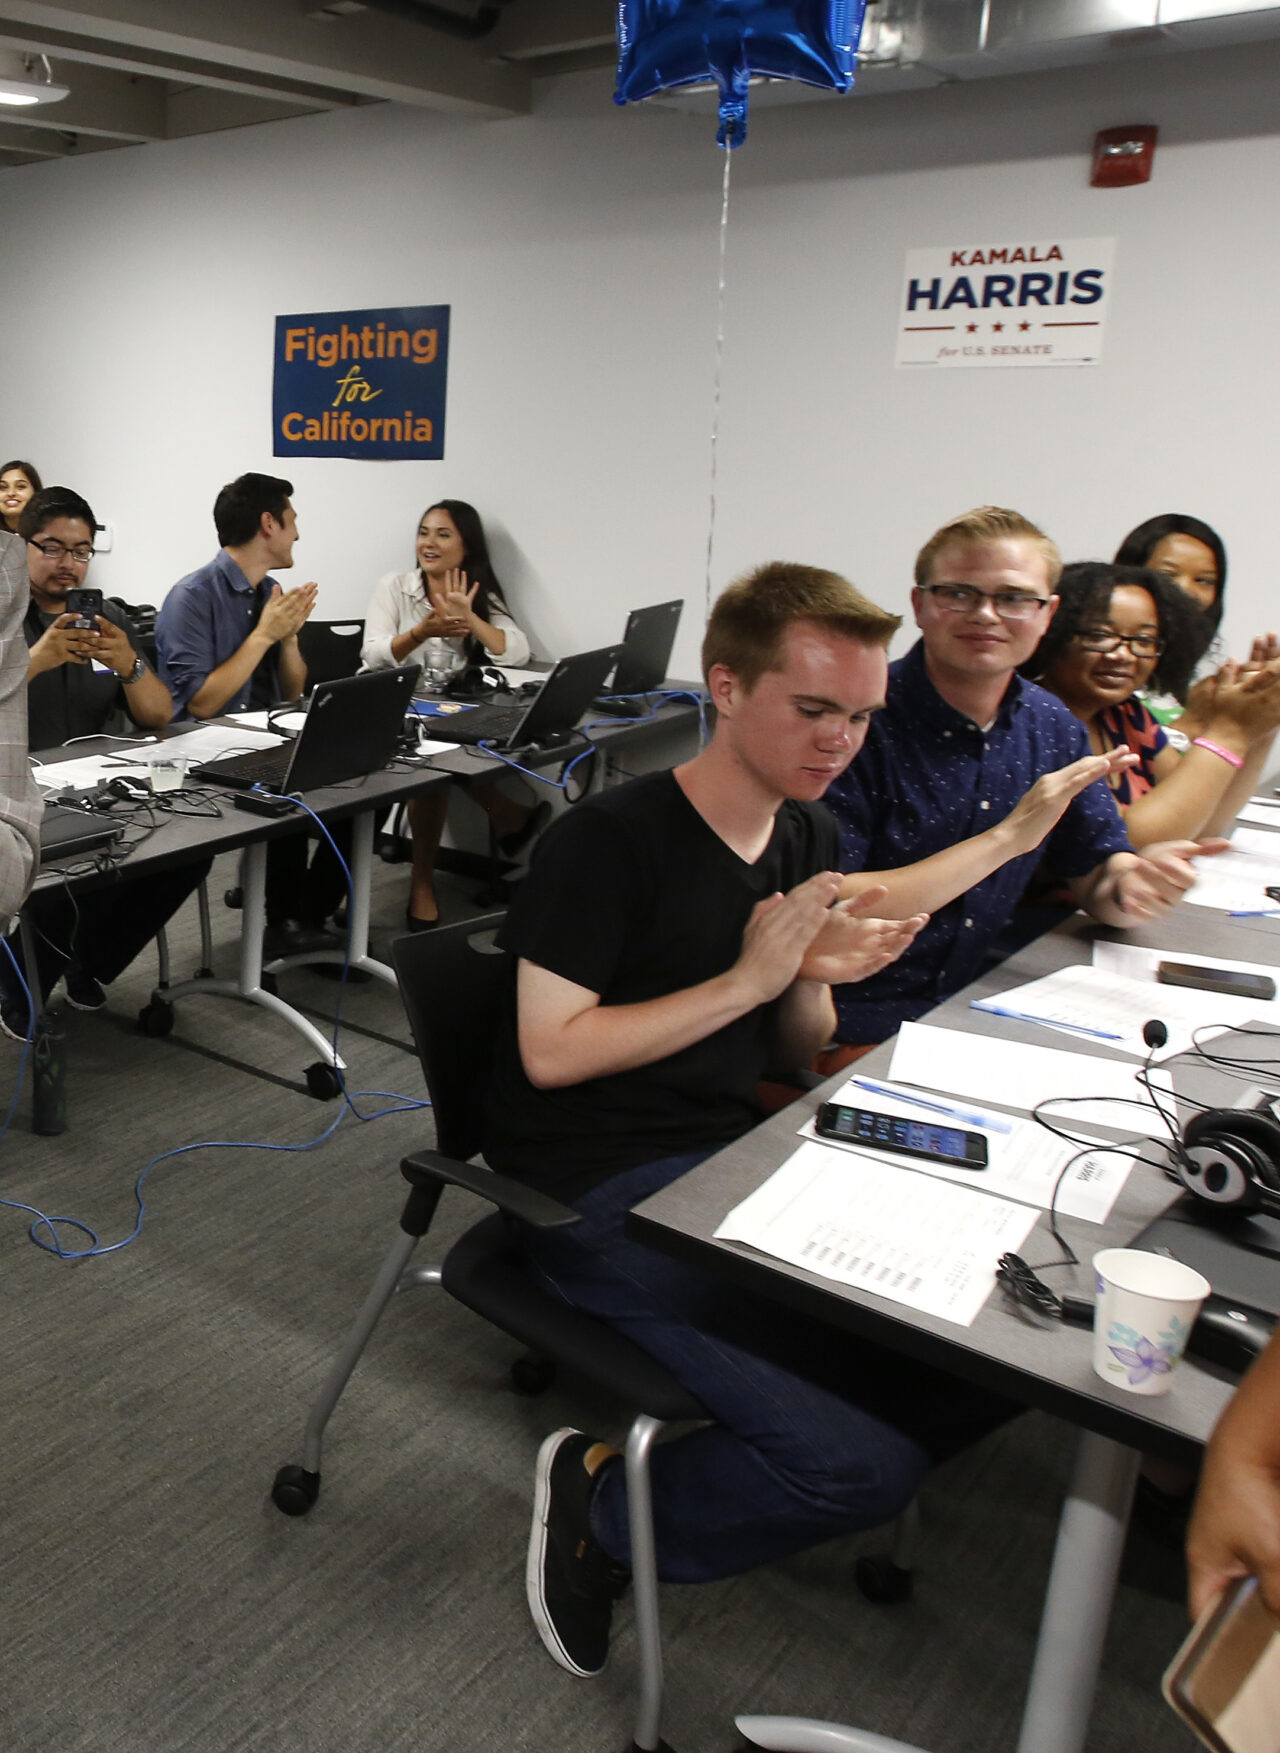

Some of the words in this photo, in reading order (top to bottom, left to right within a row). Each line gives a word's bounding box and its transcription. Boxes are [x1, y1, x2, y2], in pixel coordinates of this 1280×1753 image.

[950, 244, 1064, 267] KAMALA
[906, 268, 1105, 311] HARRIS
[285, 322, 439, 368] Fighting
[991, 344, 1053, 356] SENATE
[331, 365, 384, 407] for
[281, 410, 433, 443] California
